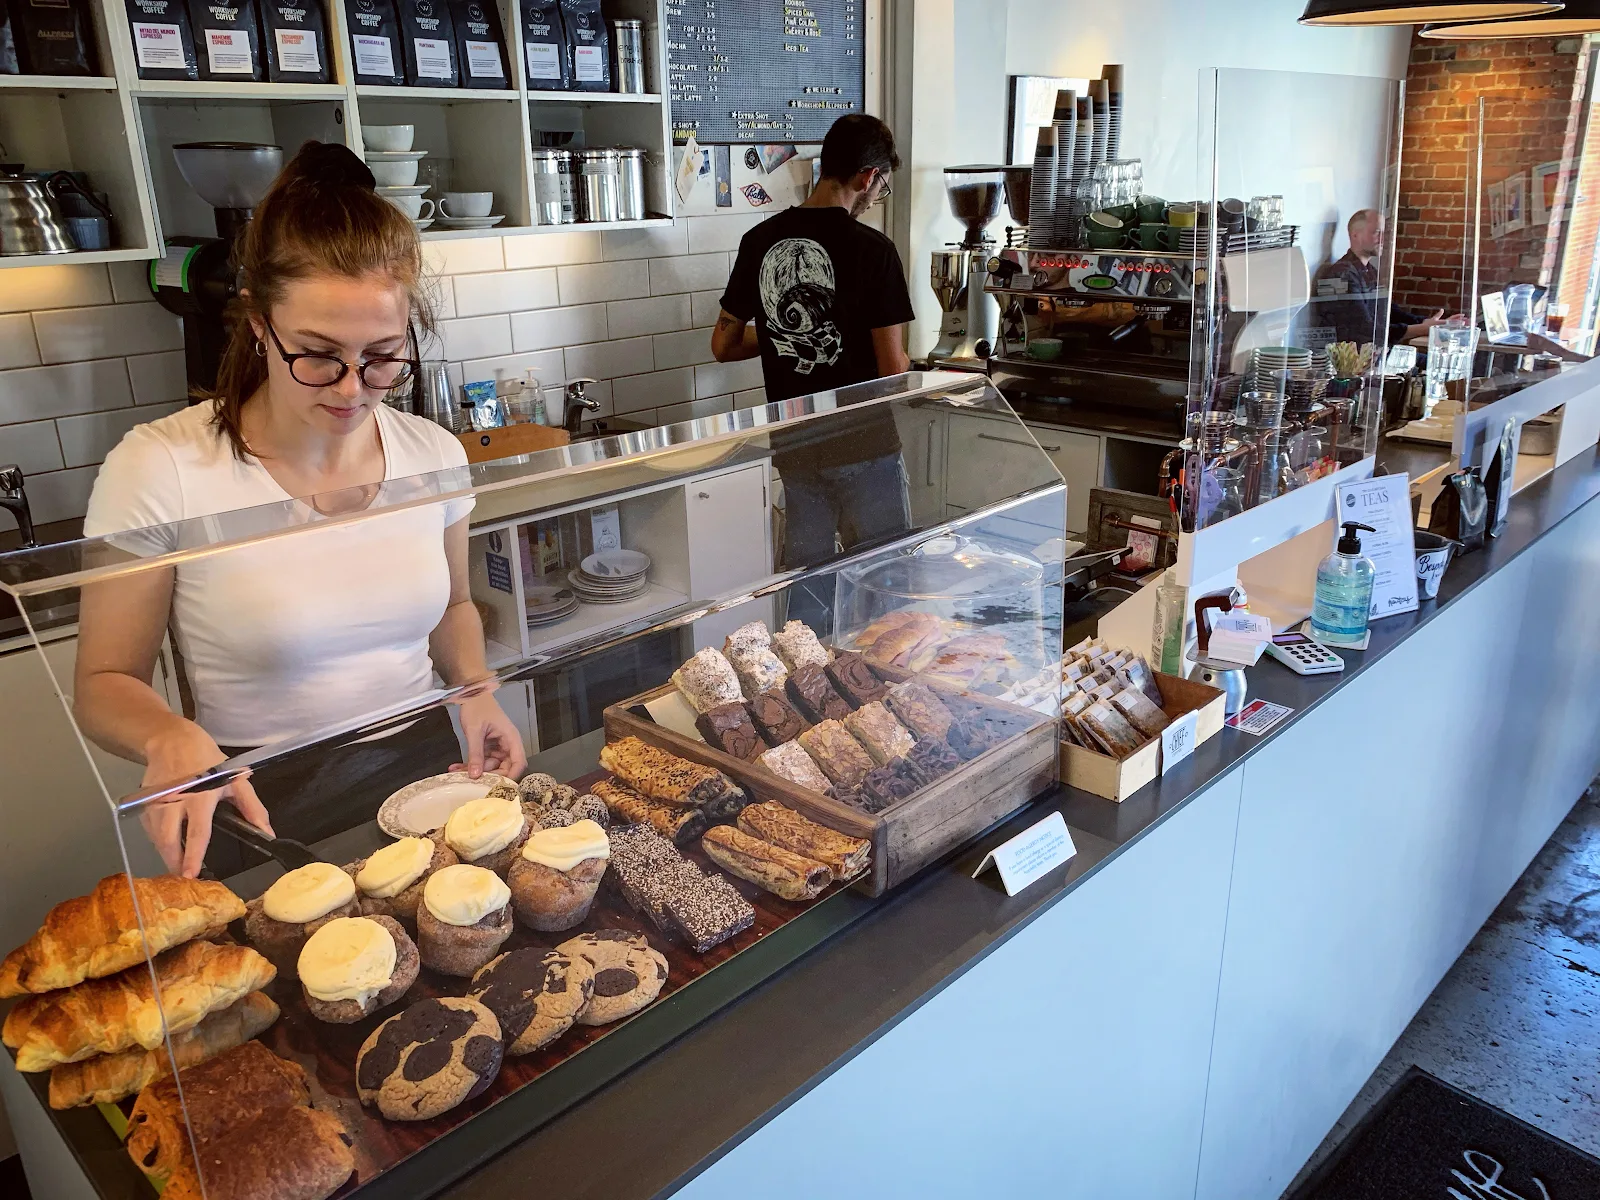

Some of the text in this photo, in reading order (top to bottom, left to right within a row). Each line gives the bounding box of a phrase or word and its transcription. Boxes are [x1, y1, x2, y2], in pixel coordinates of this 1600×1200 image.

[209, 6, 238, 14] WORKSHOP
[278, 8, 306, 16] WORKSHOP
[355, 13, 381, 21] WORKSHOP
[38, 30, 74, 38] ALLPRESS
[800, 44, 809, 52] TEA
[679, 82, 696, 91] LATTE
[684, 92, 702, 101] LATTE
[737, 111, 754, 120] EXTRA
[755, 111, 768, 120] SHOT
[672, 130, 696, 139] TANDARD
[1361, 490, 1389, 507] TEAS
